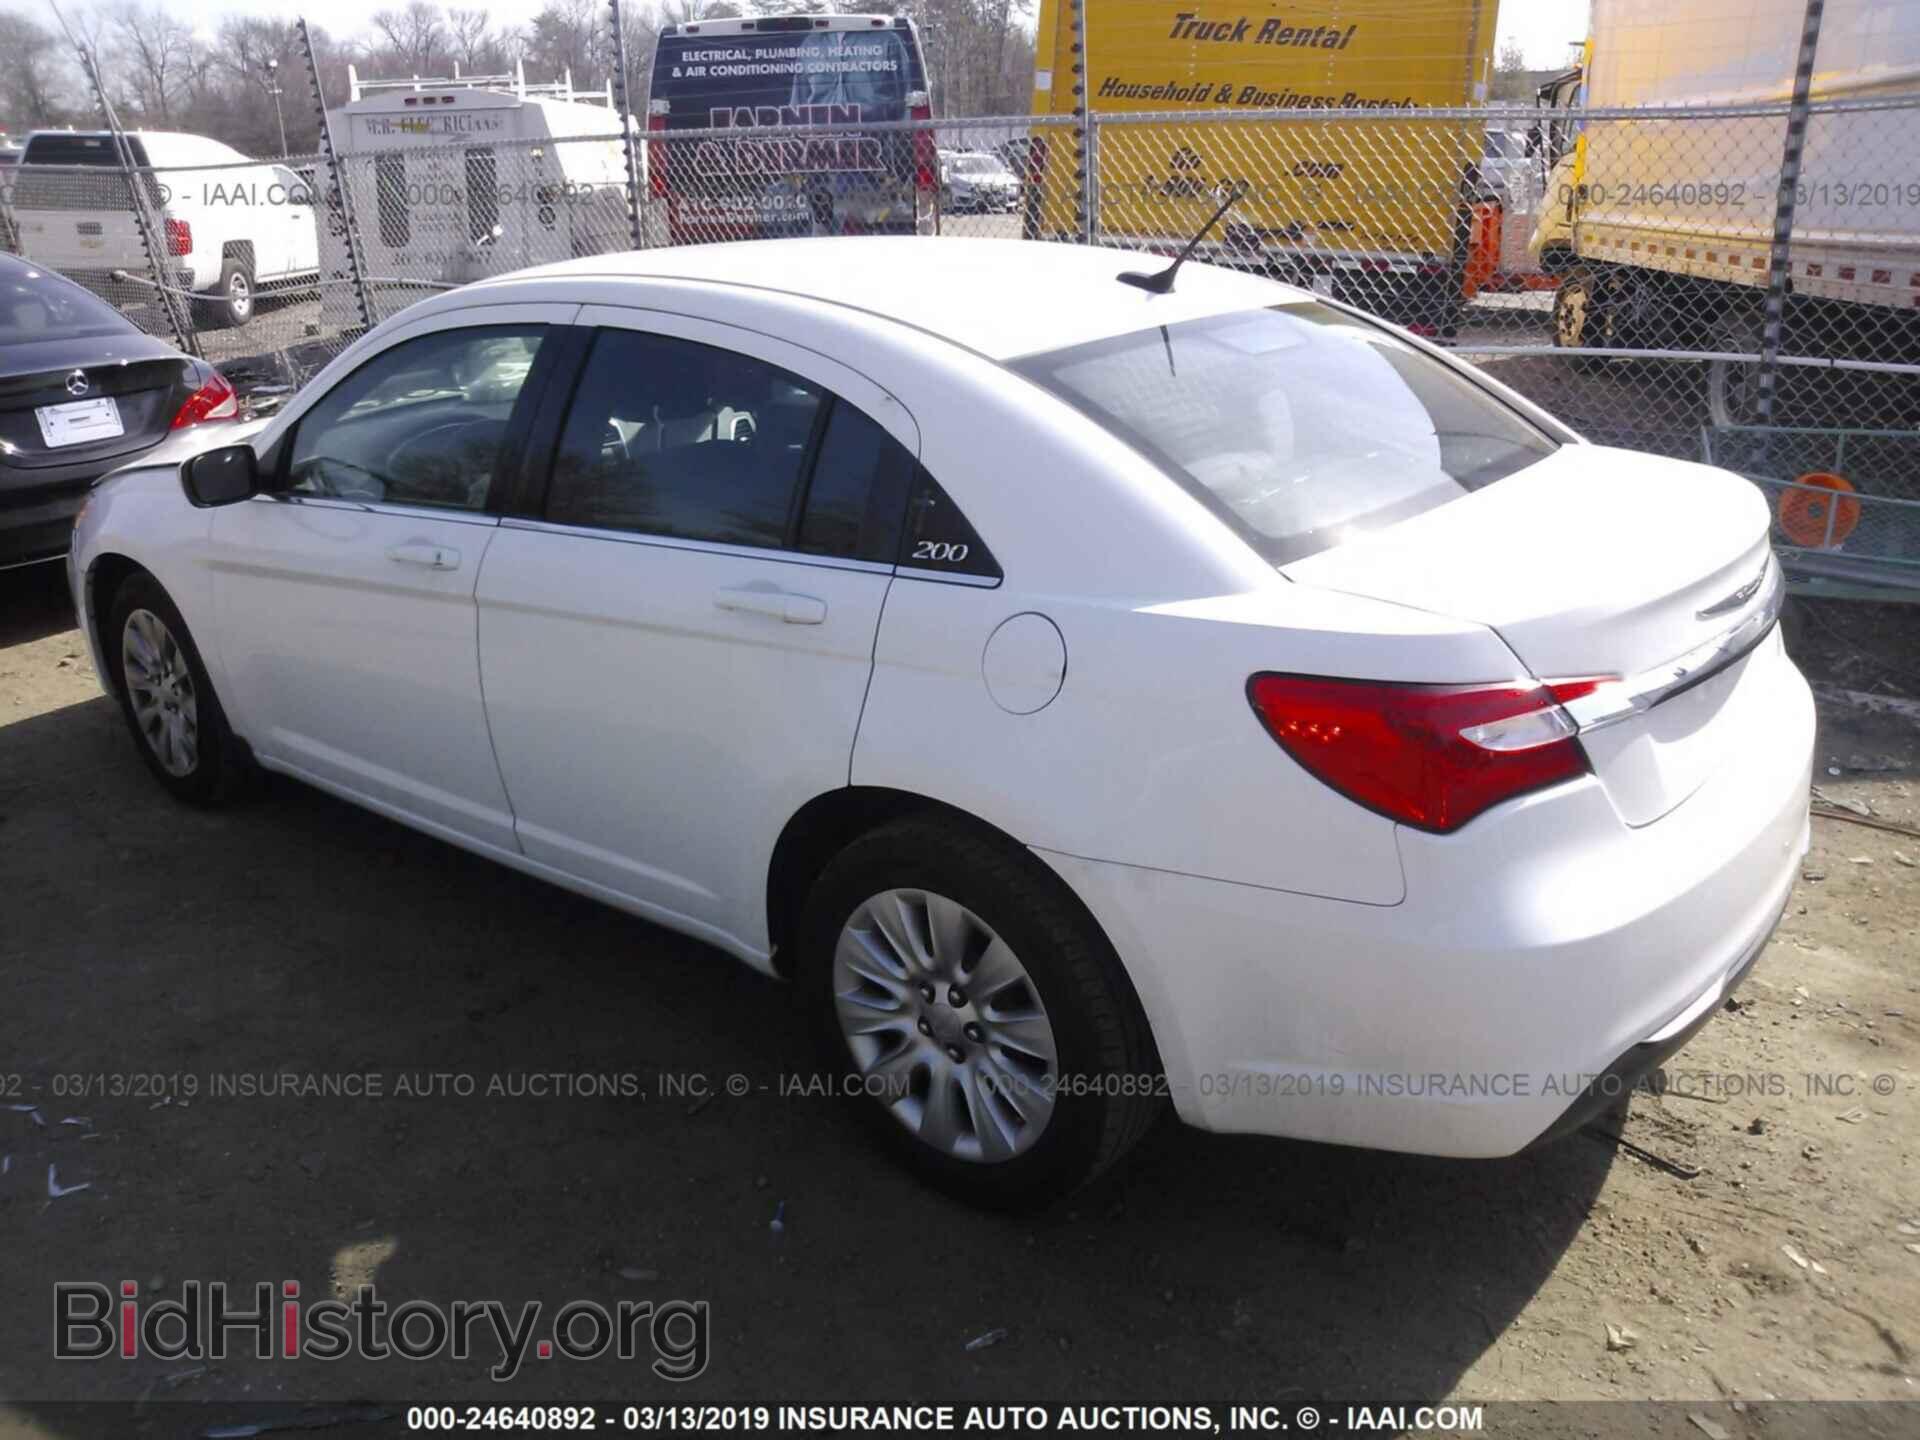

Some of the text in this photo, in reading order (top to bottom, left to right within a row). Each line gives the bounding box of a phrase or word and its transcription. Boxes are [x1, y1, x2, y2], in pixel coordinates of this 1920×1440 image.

[1169, 13, 1357, 49] Truck Rental
[682, 45, 883, 62] ELECTRICAL, PLUMBING, HEATING
[672, 60, 898, 78] & AIR CONDITIONING CONTRACTORS
[1097, 77, 1214, 104] Household
[1214, 83, 1233, 105] &
[1236, 86, 1336, 110] Business
[912, 540, 969, 562] 200
